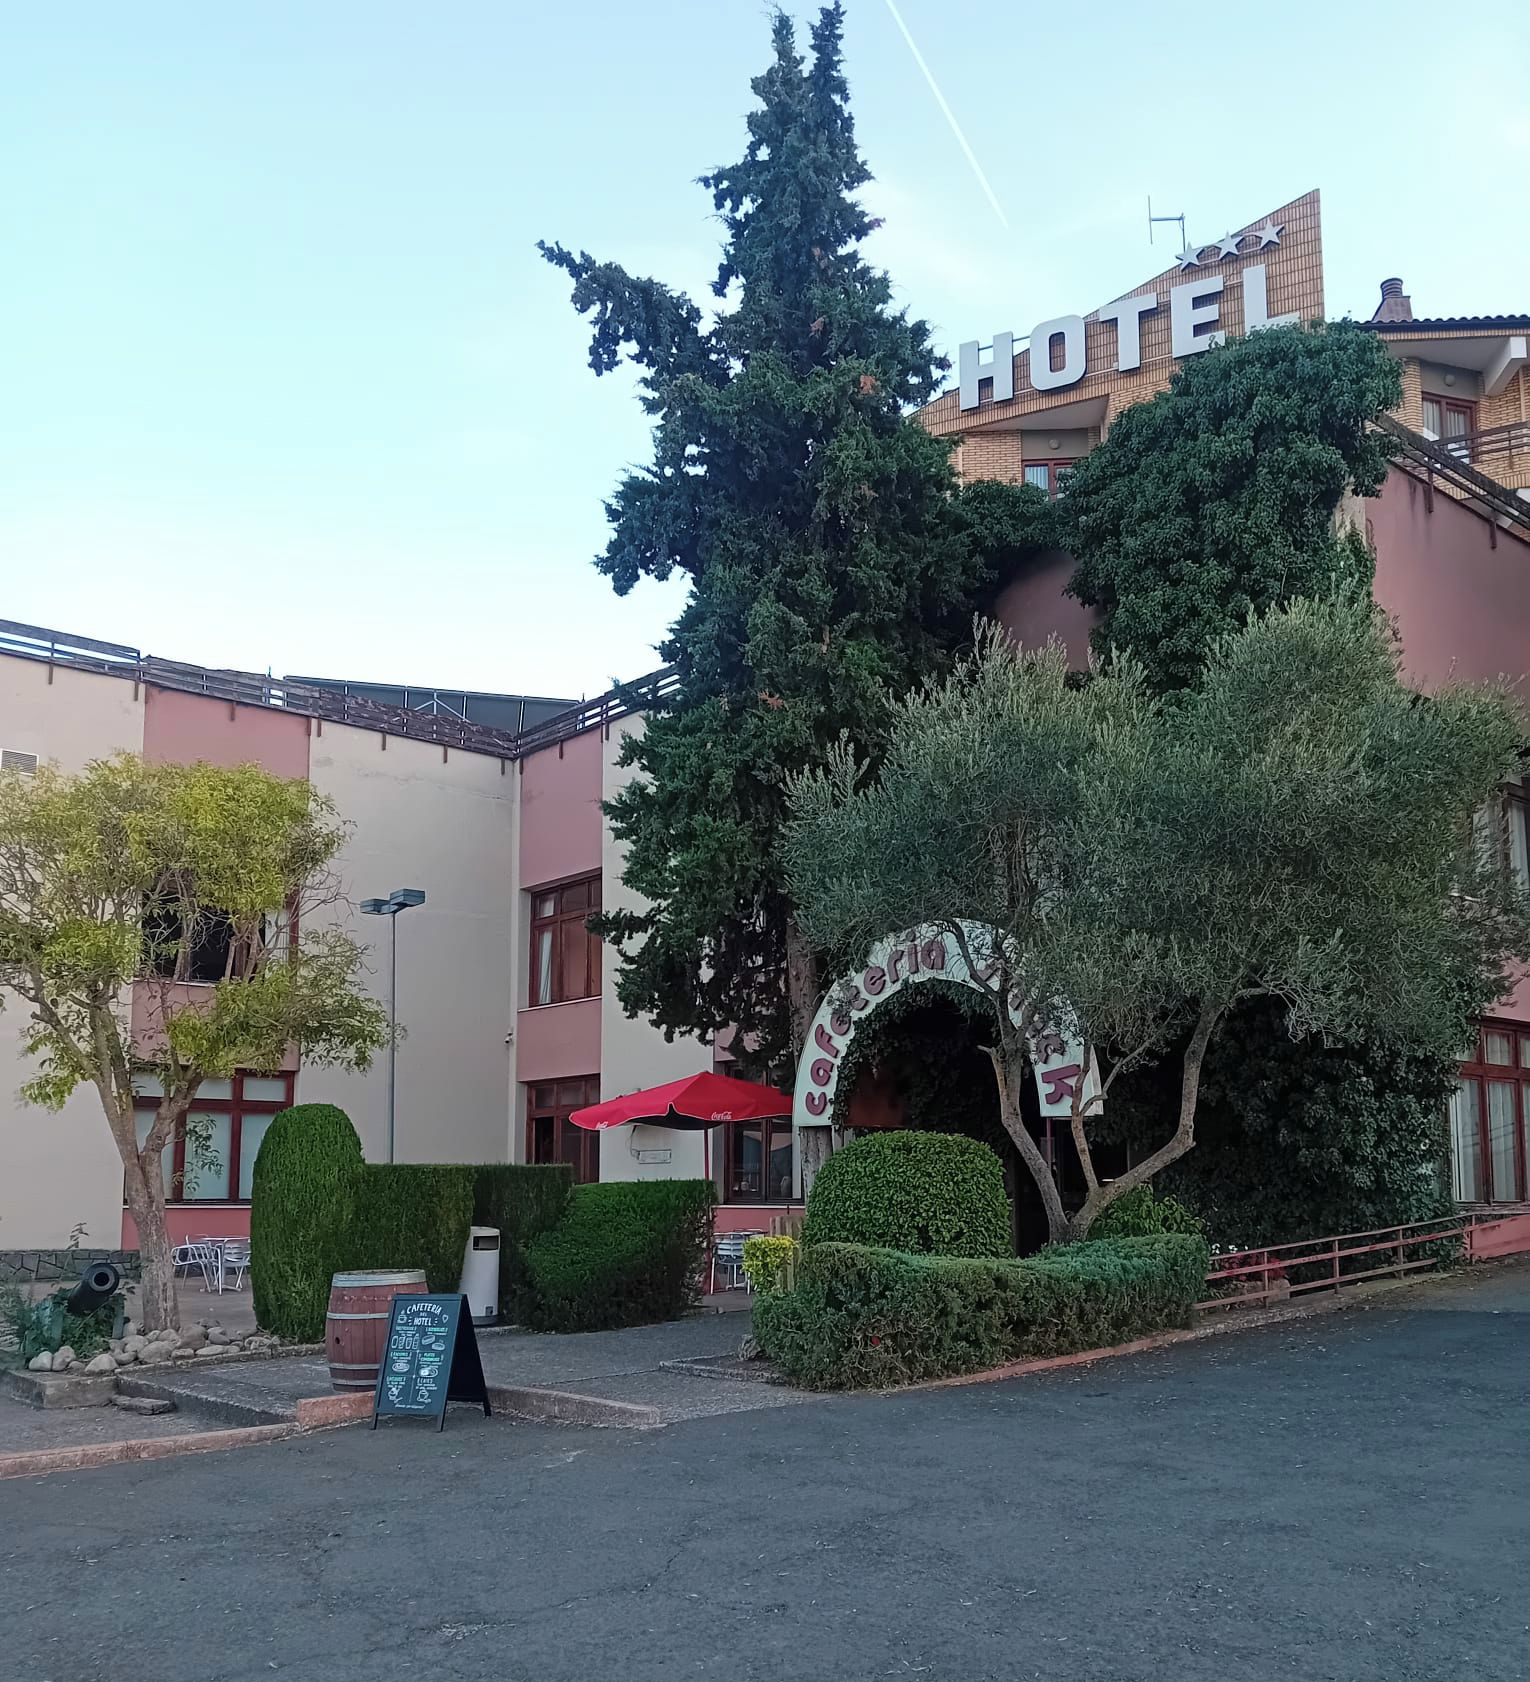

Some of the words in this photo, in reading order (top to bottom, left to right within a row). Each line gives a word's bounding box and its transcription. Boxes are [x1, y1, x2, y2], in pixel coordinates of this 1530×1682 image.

[959, 264, 1300, 411] HOTEL
[805, 929, 946, 1116] cafeteria
[413, 1317, 432, 1326] HOTEL
